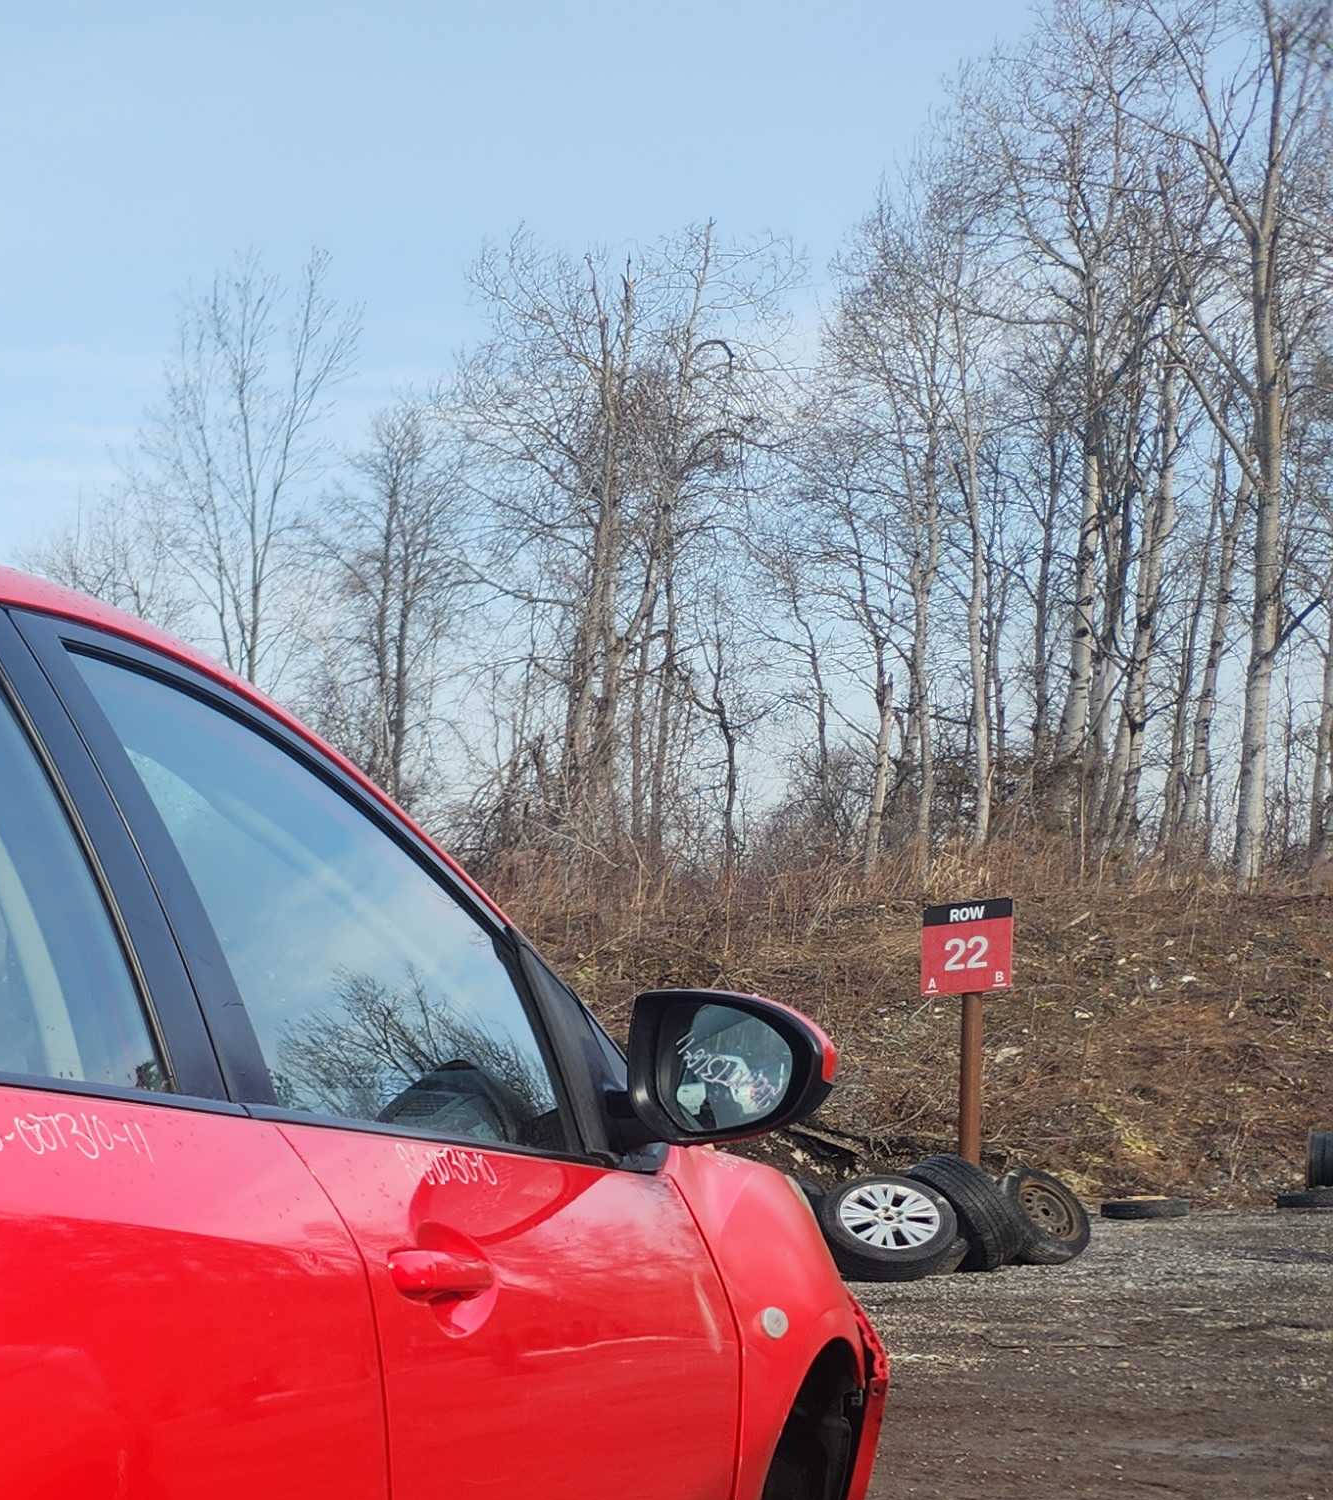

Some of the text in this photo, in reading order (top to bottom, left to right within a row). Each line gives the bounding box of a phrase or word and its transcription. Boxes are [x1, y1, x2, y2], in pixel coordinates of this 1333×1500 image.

[948, 904, 986, 923] ROW
[943, 935, 989, 972] 22
[927, 970, 1005, 989] A B
